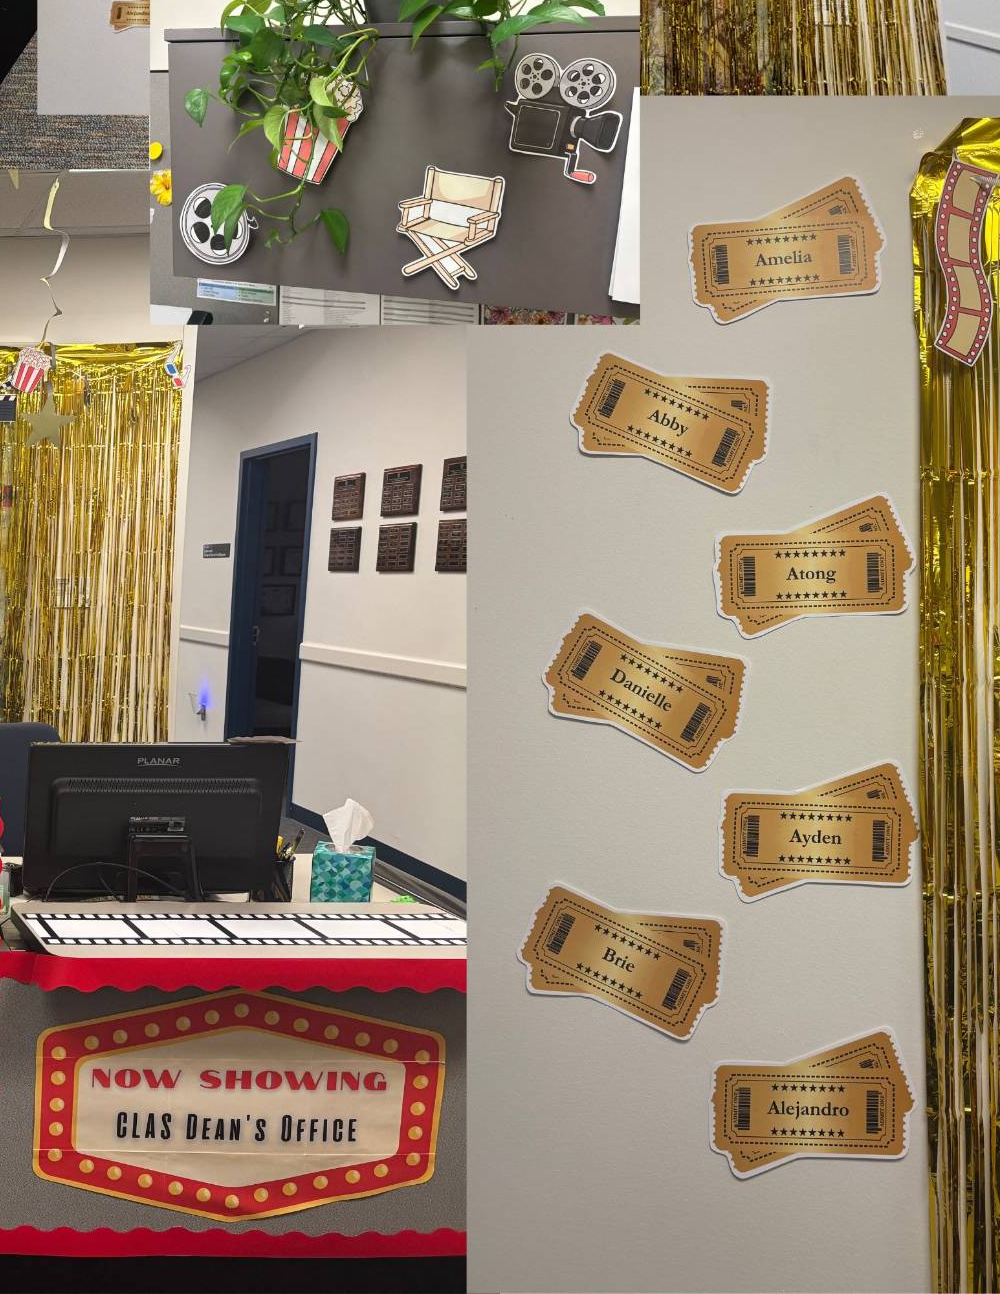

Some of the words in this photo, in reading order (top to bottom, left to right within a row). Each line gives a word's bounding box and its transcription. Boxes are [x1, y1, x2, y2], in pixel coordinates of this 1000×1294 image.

[755, 249, 813, 267] Amelia
[647, 409, 688, 437] Abby
[785, 566, 836, 584] Atong
[609, 667, 672, 712] Danielle
[788, 829, 842, 847] Ayden
[601, 946, 635, 973] Brie
[91, 1067, 183, 1090] NOW
[199, 1068, 388, 1092] SHOWING
[767, 1100, 850, 1120] Alejandro
[115, 1111, 173, 1141] CLAS
[186, 1112, 267, 1143] DEAN'S
[280, 1113, 358, 1143] OFFICE
